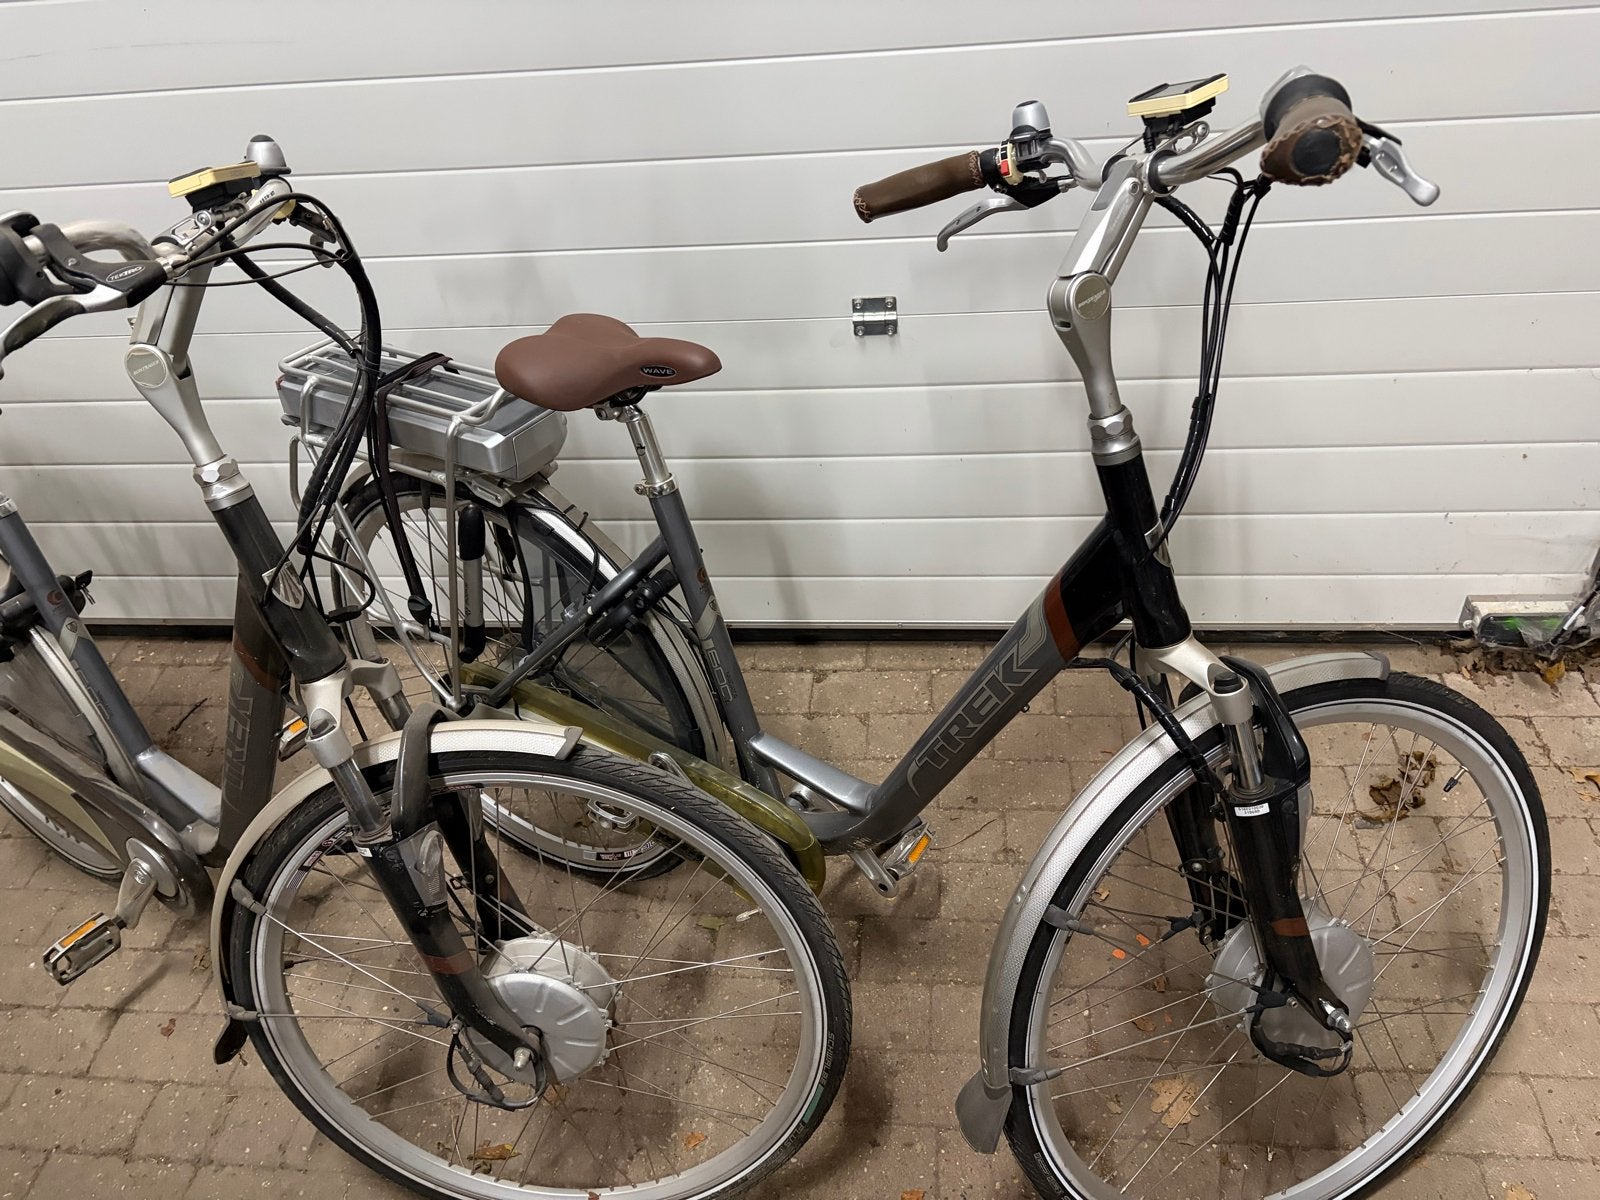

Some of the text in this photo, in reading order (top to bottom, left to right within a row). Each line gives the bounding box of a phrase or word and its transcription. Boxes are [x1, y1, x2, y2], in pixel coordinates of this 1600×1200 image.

[110, 266, 142, 280] TEKTRO
[643, 367, 674, 375] WAVE
[916, 640, 1040, 770] TREK
